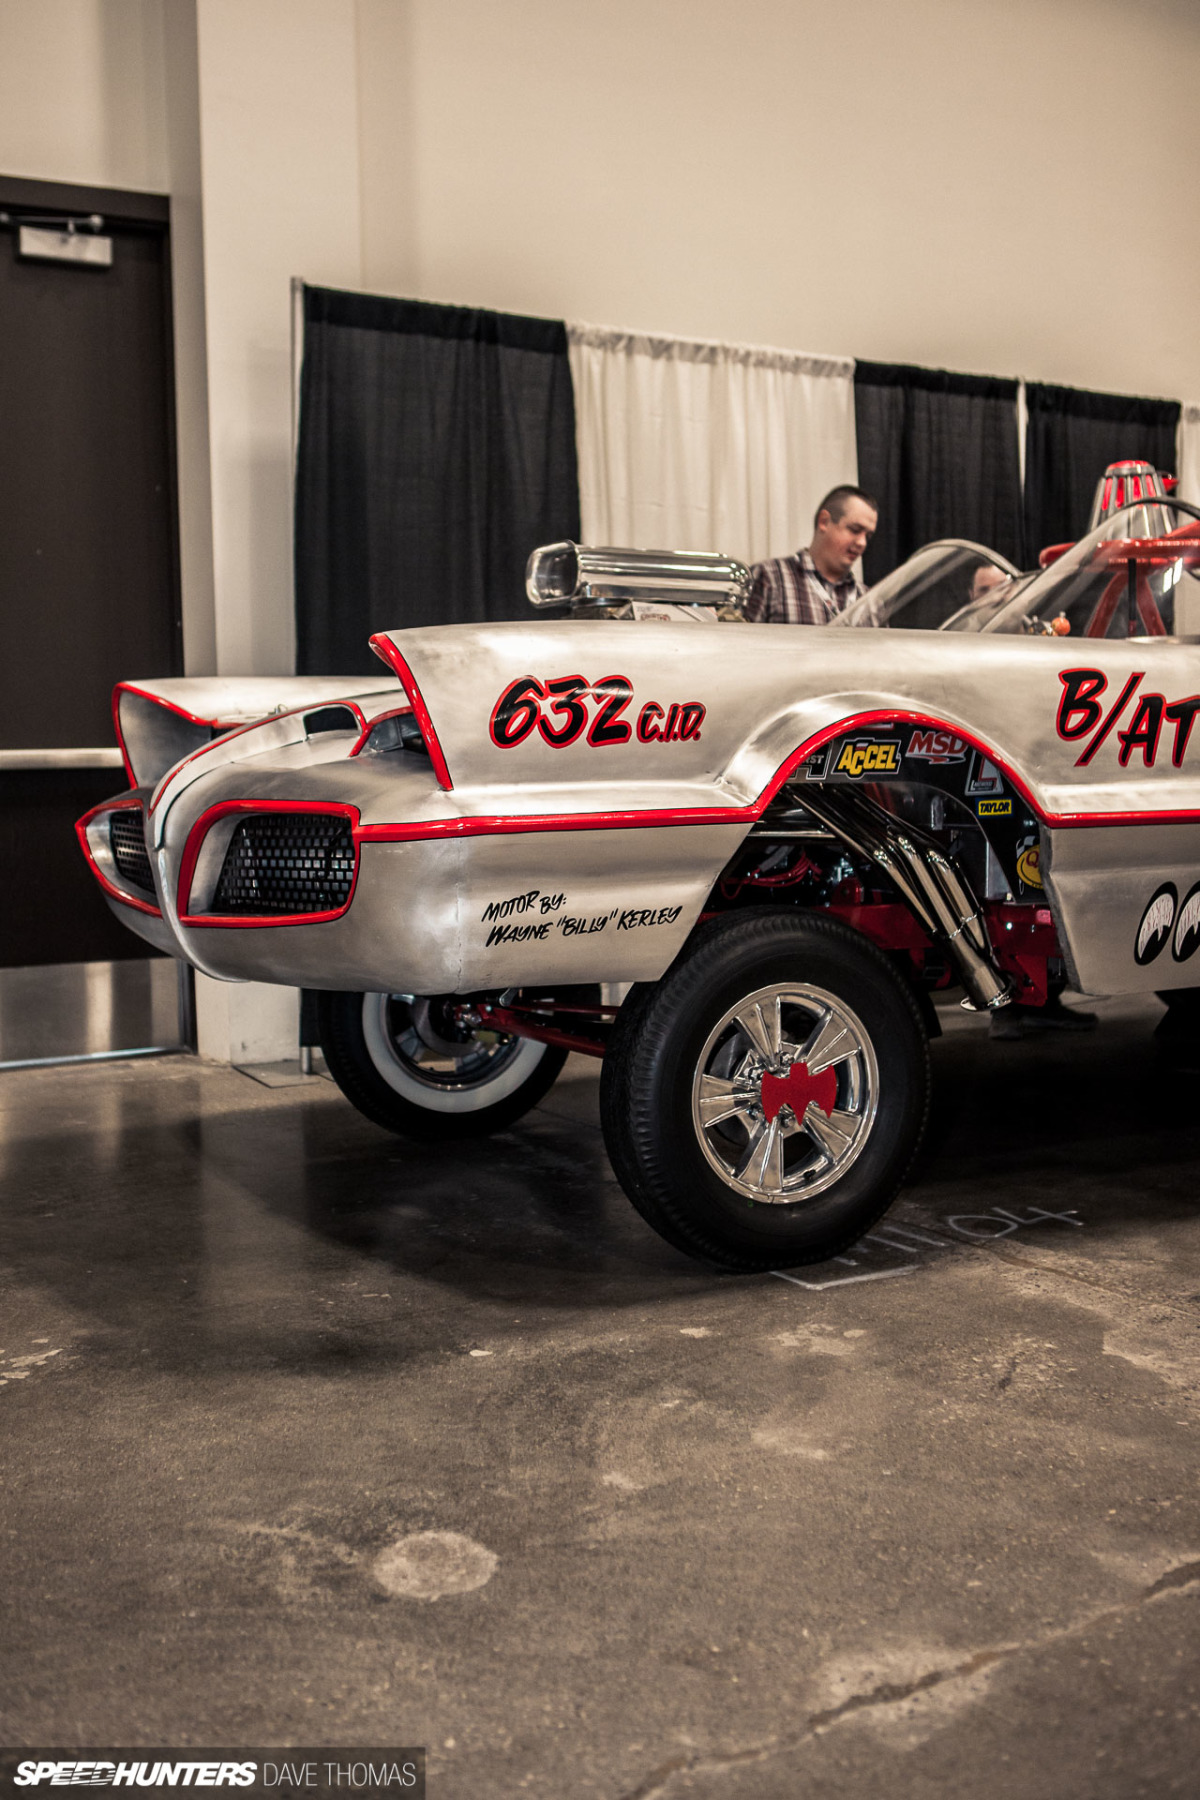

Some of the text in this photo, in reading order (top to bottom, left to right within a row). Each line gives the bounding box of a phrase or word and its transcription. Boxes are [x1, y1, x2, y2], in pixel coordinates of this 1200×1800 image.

[489, 674, 706, 749] 632 C.I.D.
[907, 731, 968, 756] MSD
[837, 744, 897, 776] ACCEL
[980, 800, 1011, 814] TAYLOR
[481, 890, 567, 923] MOTOR BY:
[485, 905, 683, 948] WAYNE "BILLY" KERLEY
